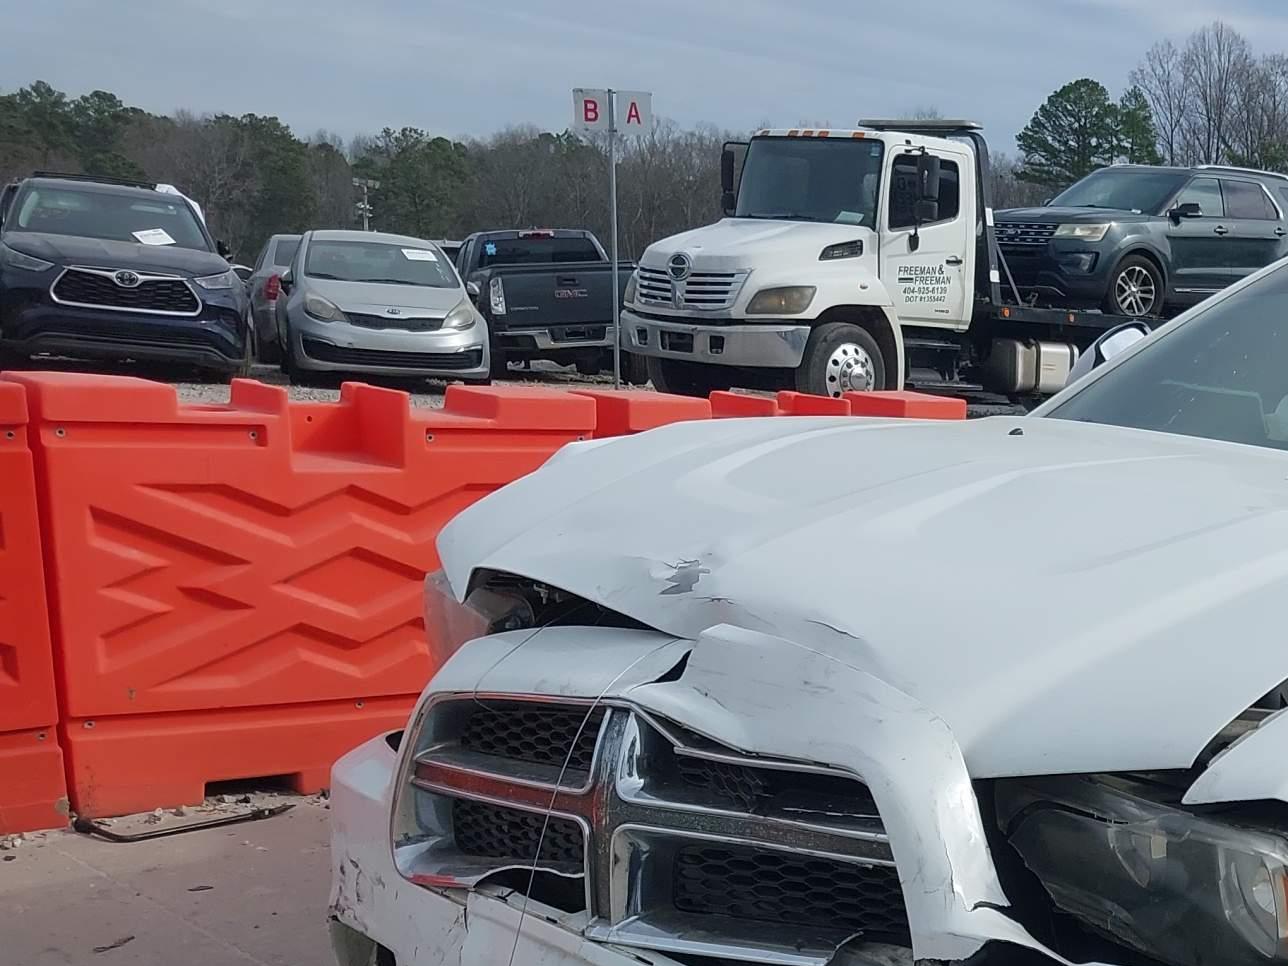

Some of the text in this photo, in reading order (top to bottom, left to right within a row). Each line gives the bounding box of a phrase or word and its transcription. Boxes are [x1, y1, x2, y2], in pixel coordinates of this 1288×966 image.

[583, 99, 599, 122] B
[626, 102, 641, 124] A
[898, 264, 945, 276] FREEMAN &
[914, 276, 952, 285] FREEMAN
[902, 286, 948, 295] 404-925-6139
[904, 295, 918, 303] DOT
